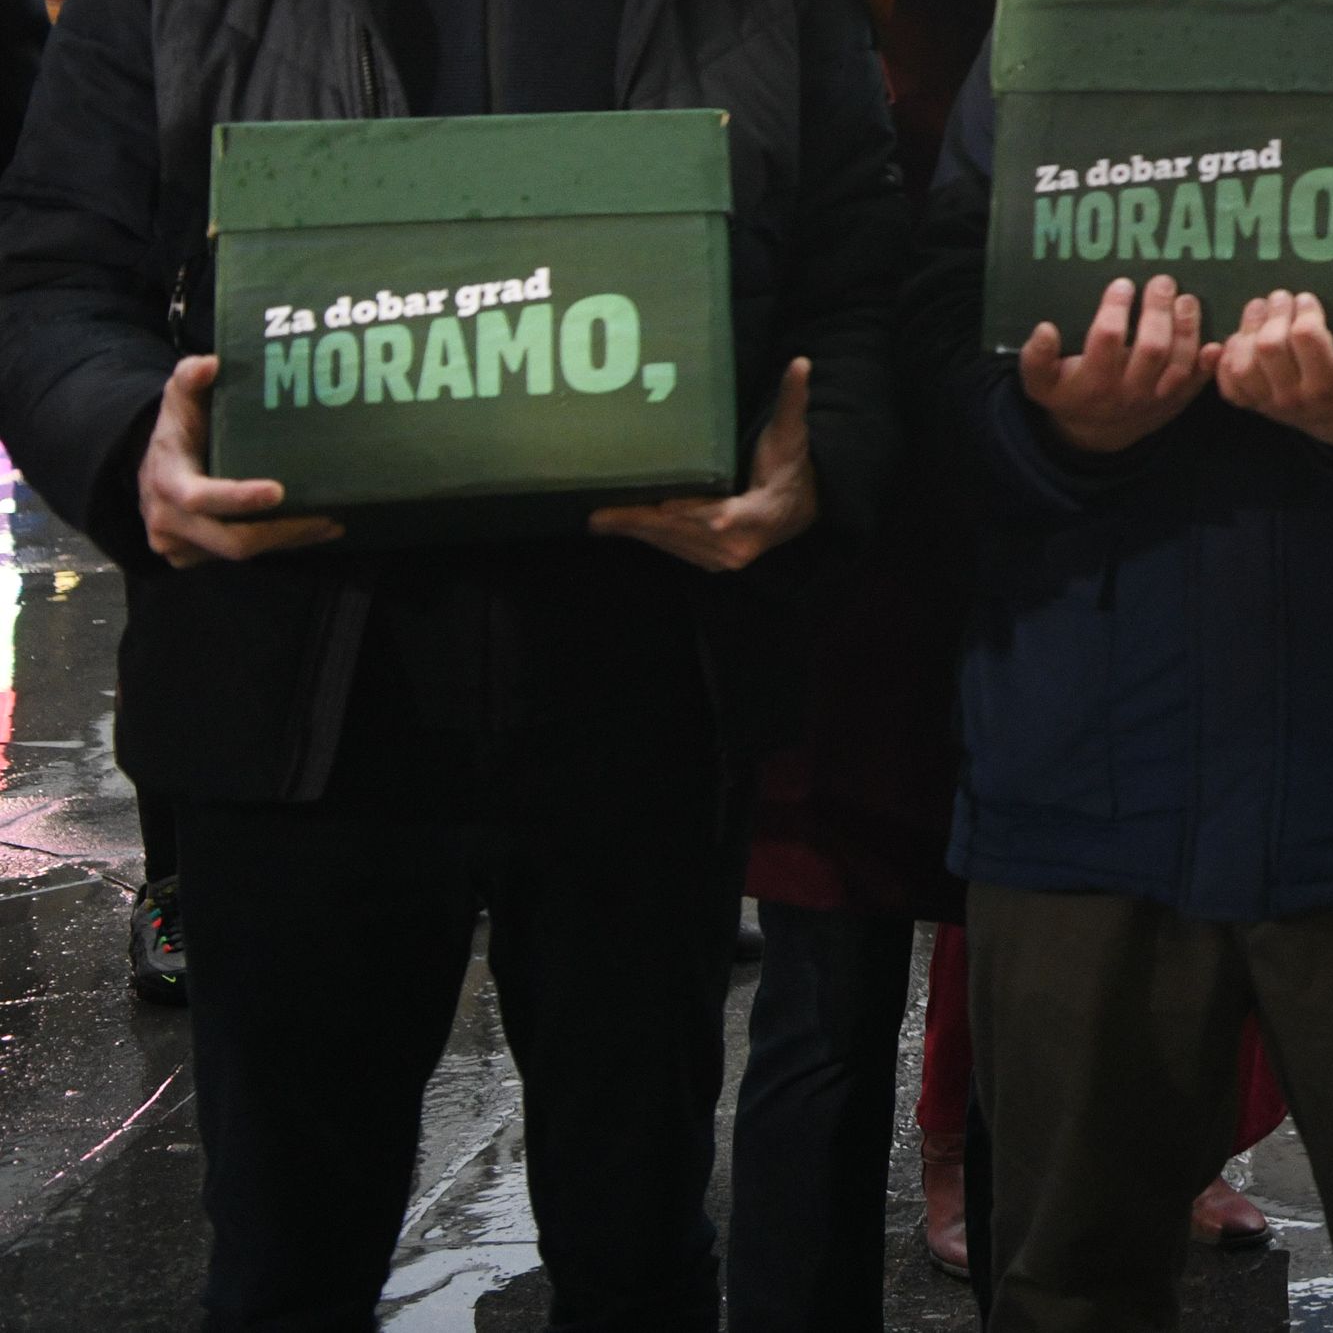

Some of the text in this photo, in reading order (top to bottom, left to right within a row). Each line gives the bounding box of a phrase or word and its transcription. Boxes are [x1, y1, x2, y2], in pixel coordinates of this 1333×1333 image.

[1034, 138, 1282, 193] Za dobar grad
[264, 266, 553, 338] Za dobar grad
[264, 293, 677, 410] MORAMO,
